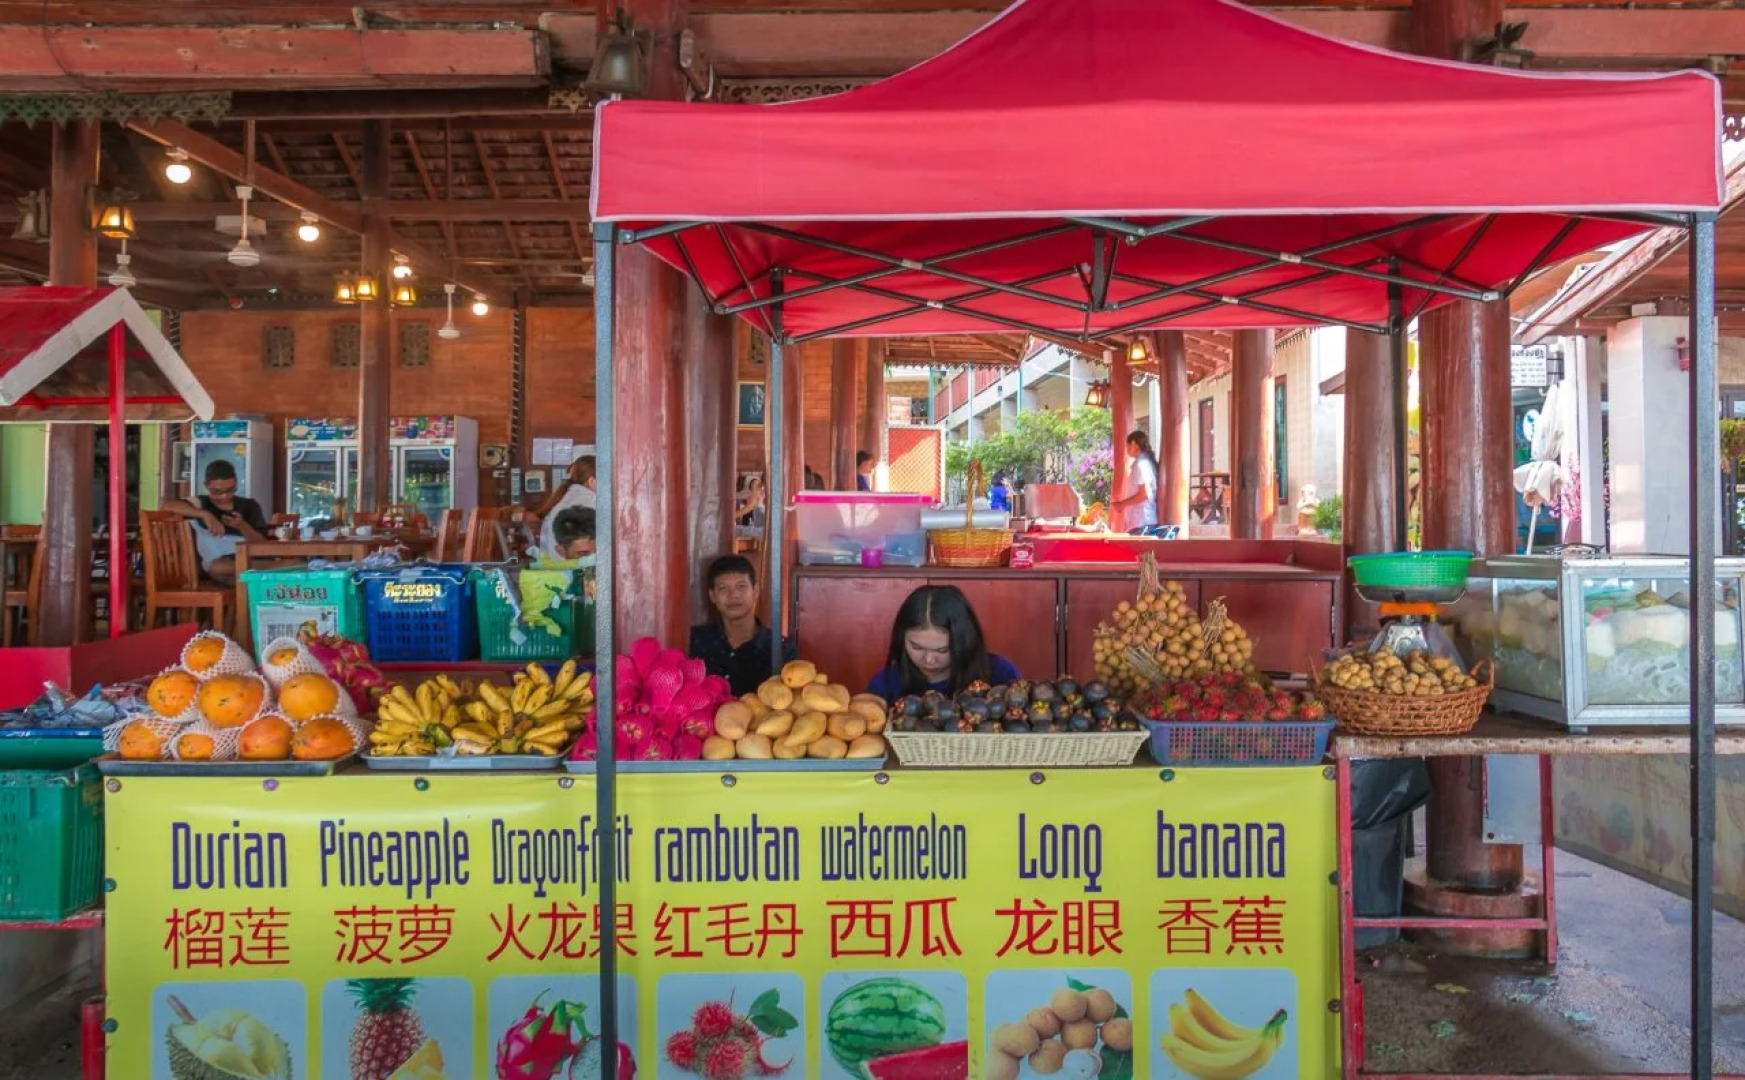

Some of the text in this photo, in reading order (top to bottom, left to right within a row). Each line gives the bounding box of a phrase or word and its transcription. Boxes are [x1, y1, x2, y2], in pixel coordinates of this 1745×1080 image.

[172, 820, 287, 889] Durian
[319, 818, 470, 899] Pineapple
[492, 815, 633, 897] Dragonfrit
[655, 814, 799, 882] rambutan
[821, 812, 966, 881] watermelon
[1019, 813, 1102, 892] Long
[1157, 810, 1286, 879] banana
[164, 907, 291, 969] 榴莲
[333, 904, 455, 964] 菠萝
[654, 901, 804, 958] 红毛丹
[826, 897, 963, 958] 西瓜
[994, 898, 1124, 958] 龙眼
[1157, 895, 1287, 955] 香蕉
